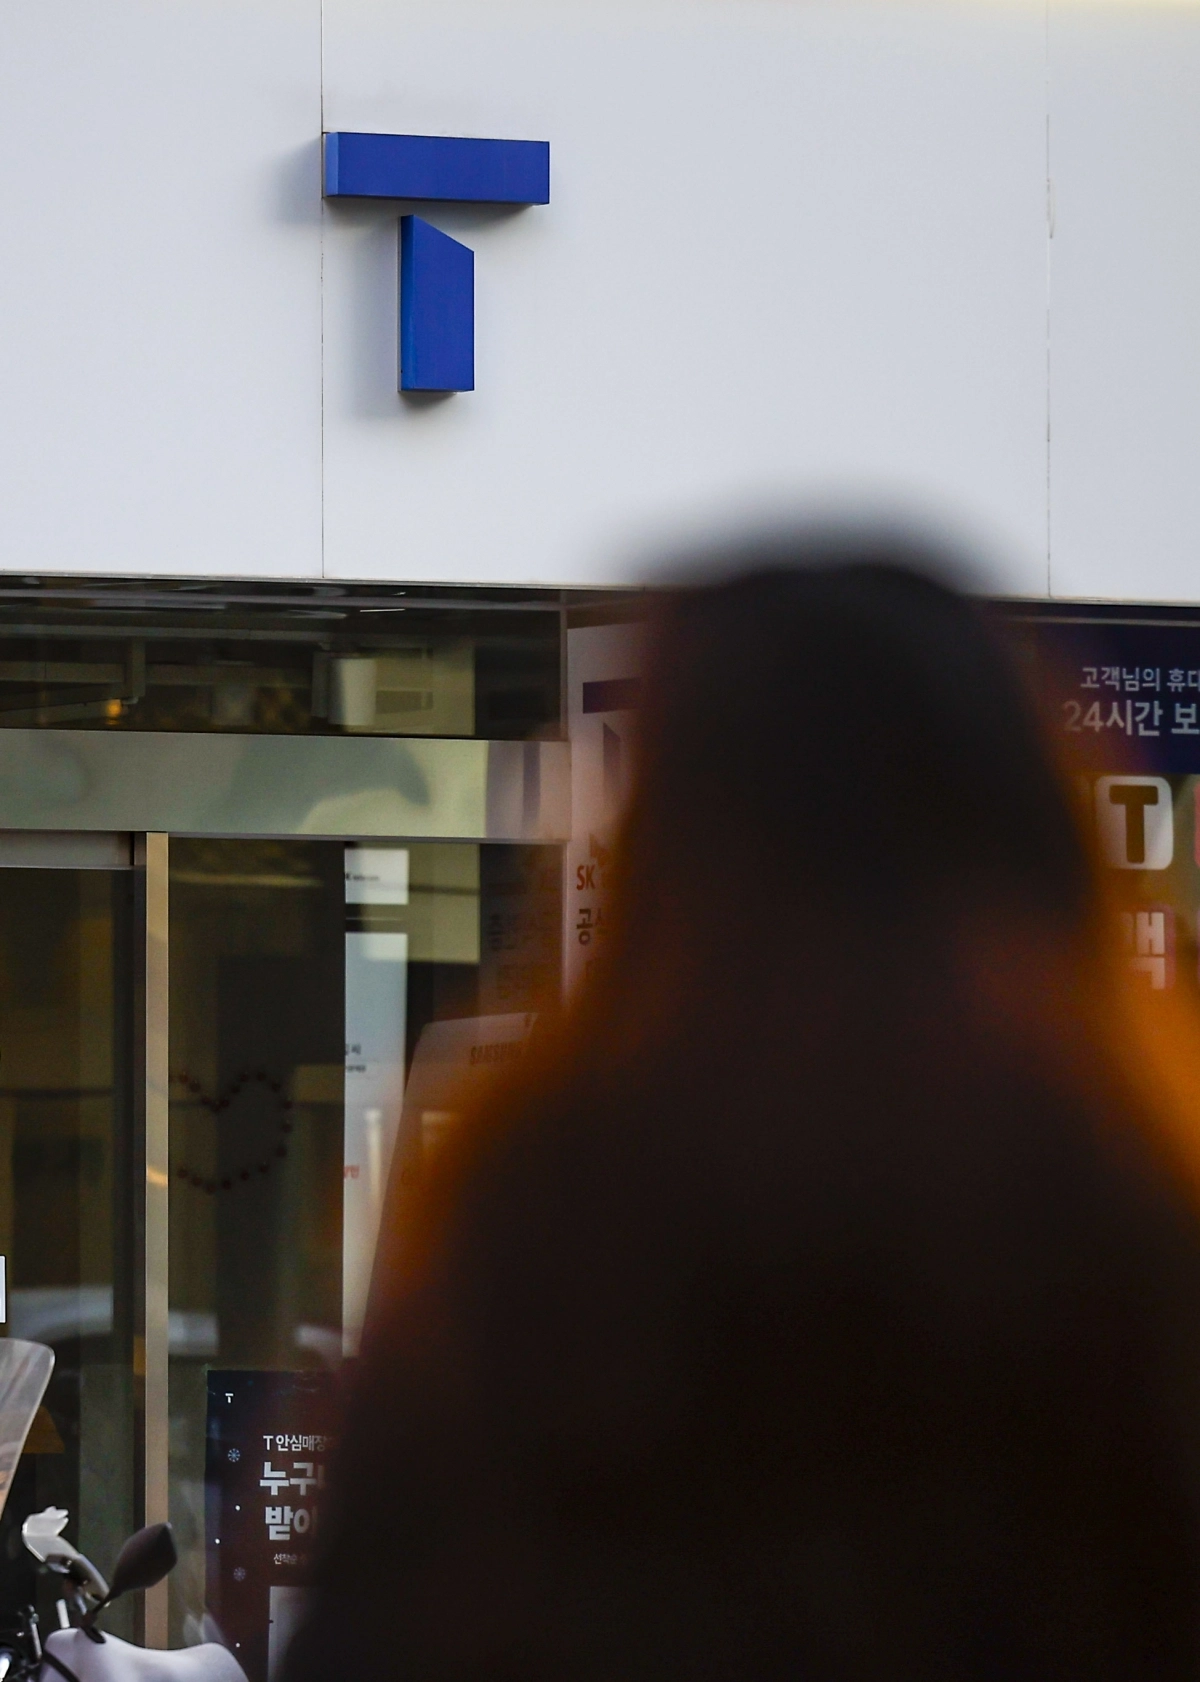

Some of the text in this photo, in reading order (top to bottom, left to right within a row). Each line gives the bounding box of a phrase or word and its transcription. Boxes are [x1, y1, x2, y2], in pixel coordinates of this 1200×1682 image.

[324, 131, 549, 392] T
[1080, 666, 1160, 692] 고객님의
[1063, 699, 1163, 736] 24시간
[263, 1435, 274, 1451] T
